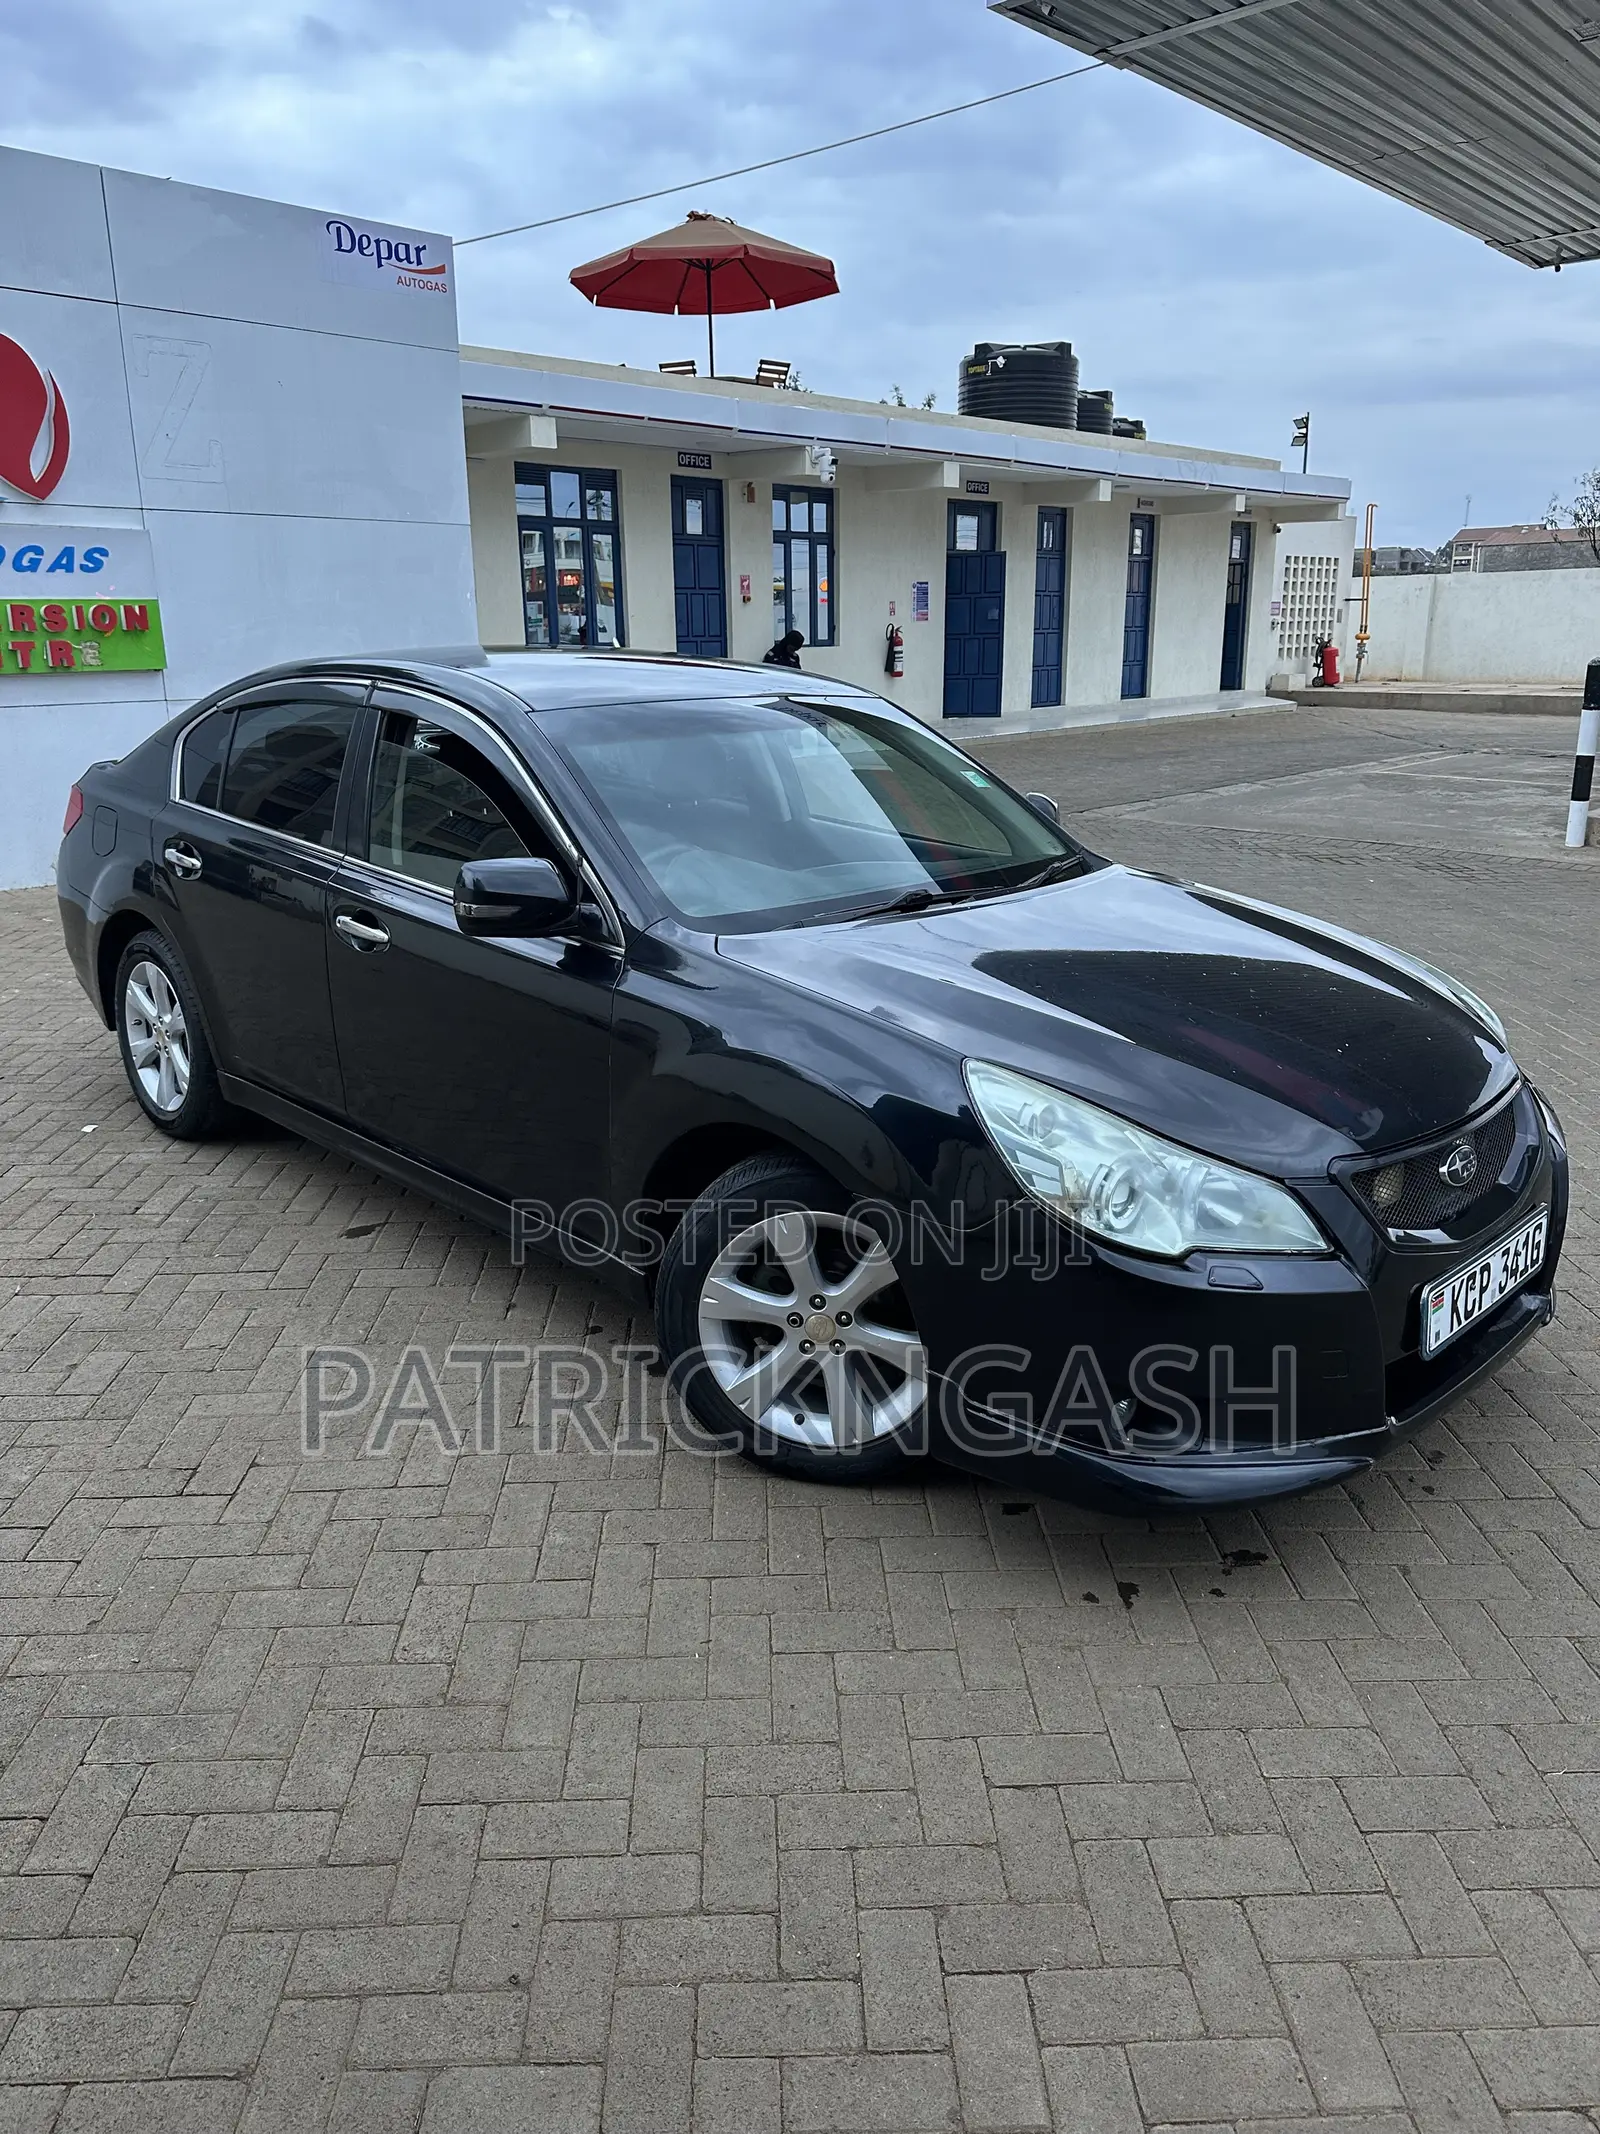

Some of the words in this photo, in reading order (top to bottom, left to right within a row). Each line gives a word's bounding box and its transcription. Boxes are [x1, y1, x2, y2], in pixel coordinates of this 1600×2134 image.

[326, 220, 427, 269] Depar
[397, 275, 447, 293] AUTOGAS
[679, 453, 710, 467] OFFICE
[967, 482, 988, 492] OFFICE
[0, 545, 110, 573] GAS
[0, 604, 149, 633] RSION
[0, 640, 103, 669] TRE
[1450, 1261, 1492, 1334] KCP
[1498, 1221, 1543, 1295] 341G
